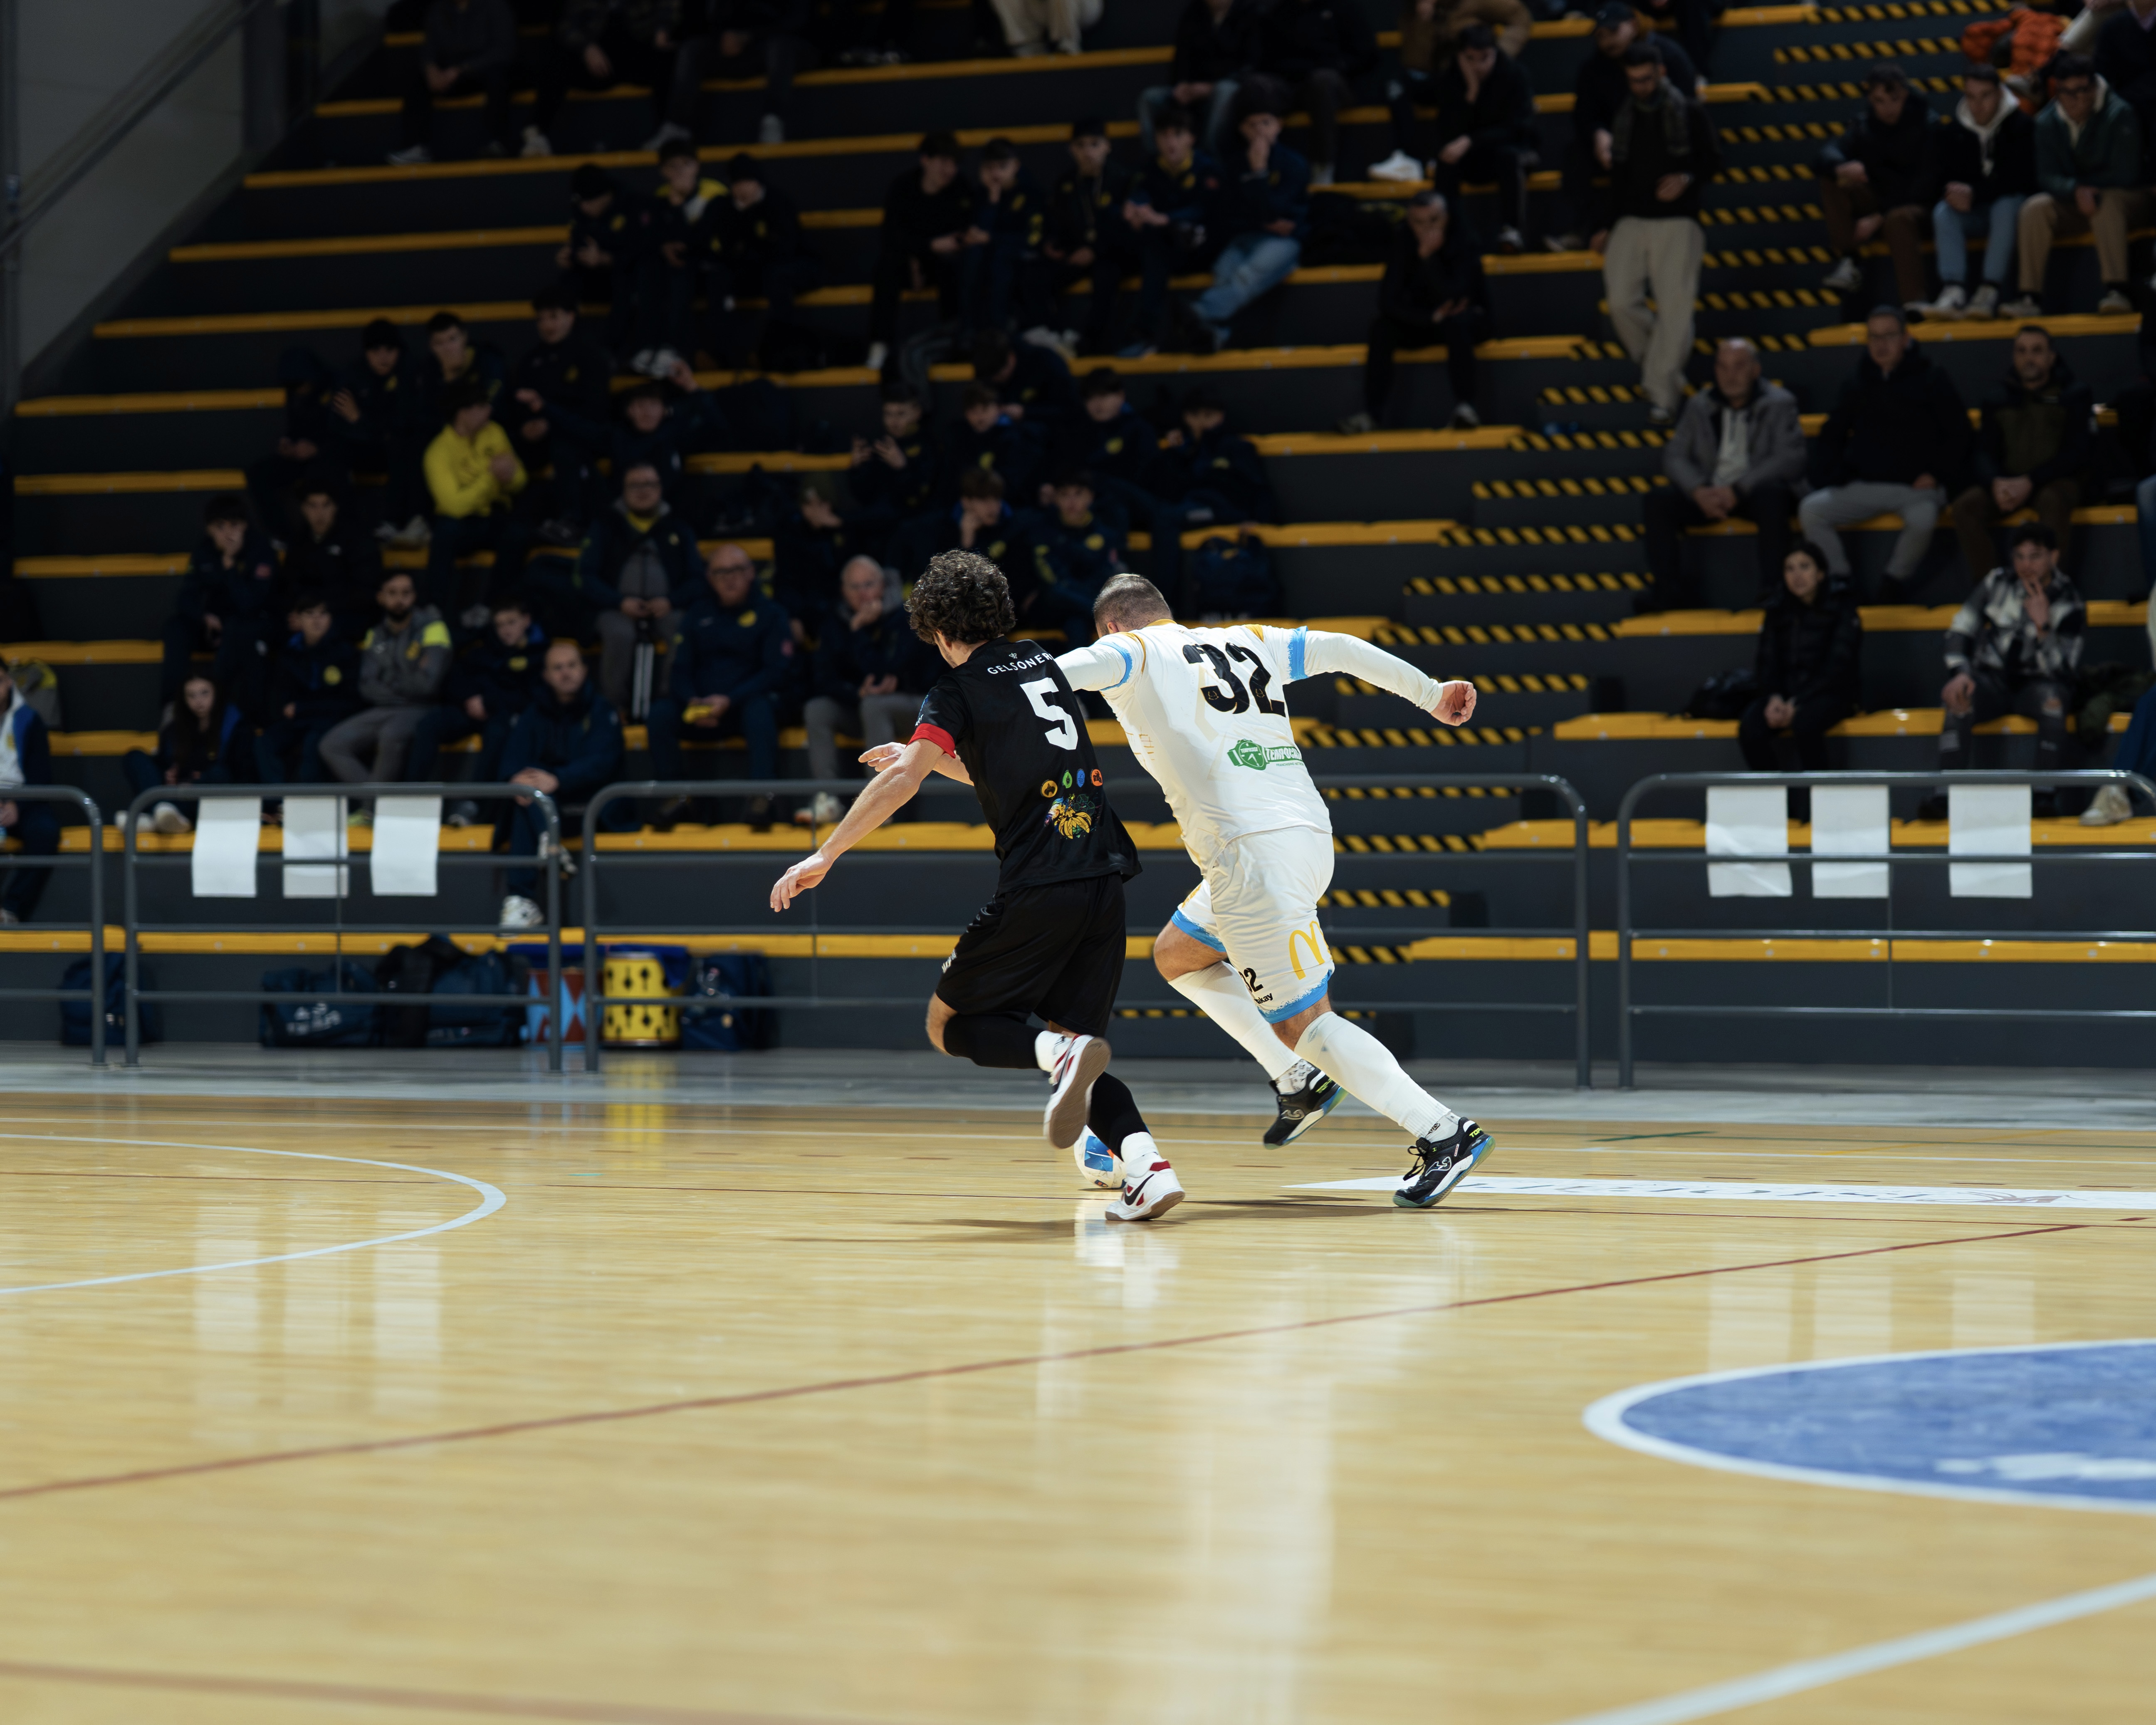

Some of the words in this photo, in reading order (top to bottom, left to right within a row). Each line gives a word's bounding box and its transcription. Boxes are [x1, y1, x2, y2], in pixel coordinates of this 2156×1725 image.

[1182, 642, 1286, 718] 32
[1019, 677, 1078, 750] 5
[1254, 993, 1273, 1004] akay
[1469, 1127, 1483, 1138] TOP
